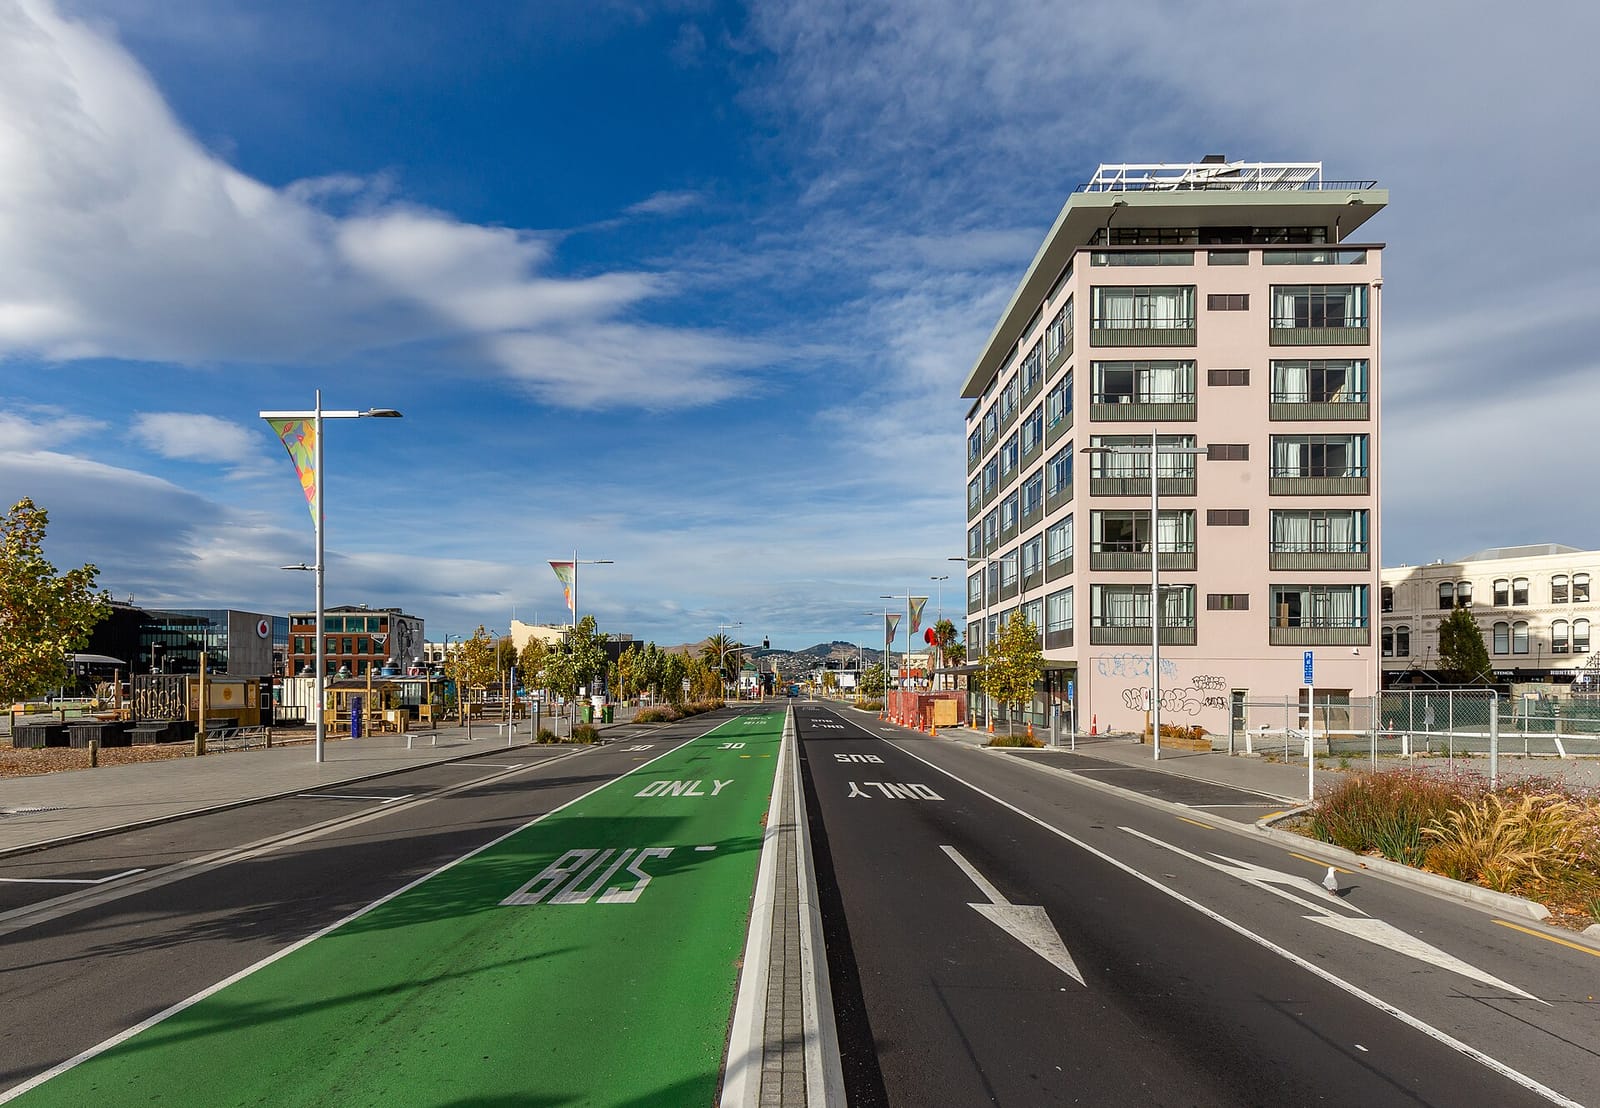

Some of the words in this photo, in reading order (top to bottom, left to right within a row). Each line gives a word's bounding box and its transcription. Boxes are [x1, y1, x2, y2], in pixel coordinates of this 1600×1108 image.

[619, 744, 655, 752] 30
[717, 742, 746, 750] 30
[833, 753, 885, 764] BUS
[633, 779, 735, 798] ONLY
[847, 781, 945, 801] ONLY
[498, 847, 676, 905] BUS
